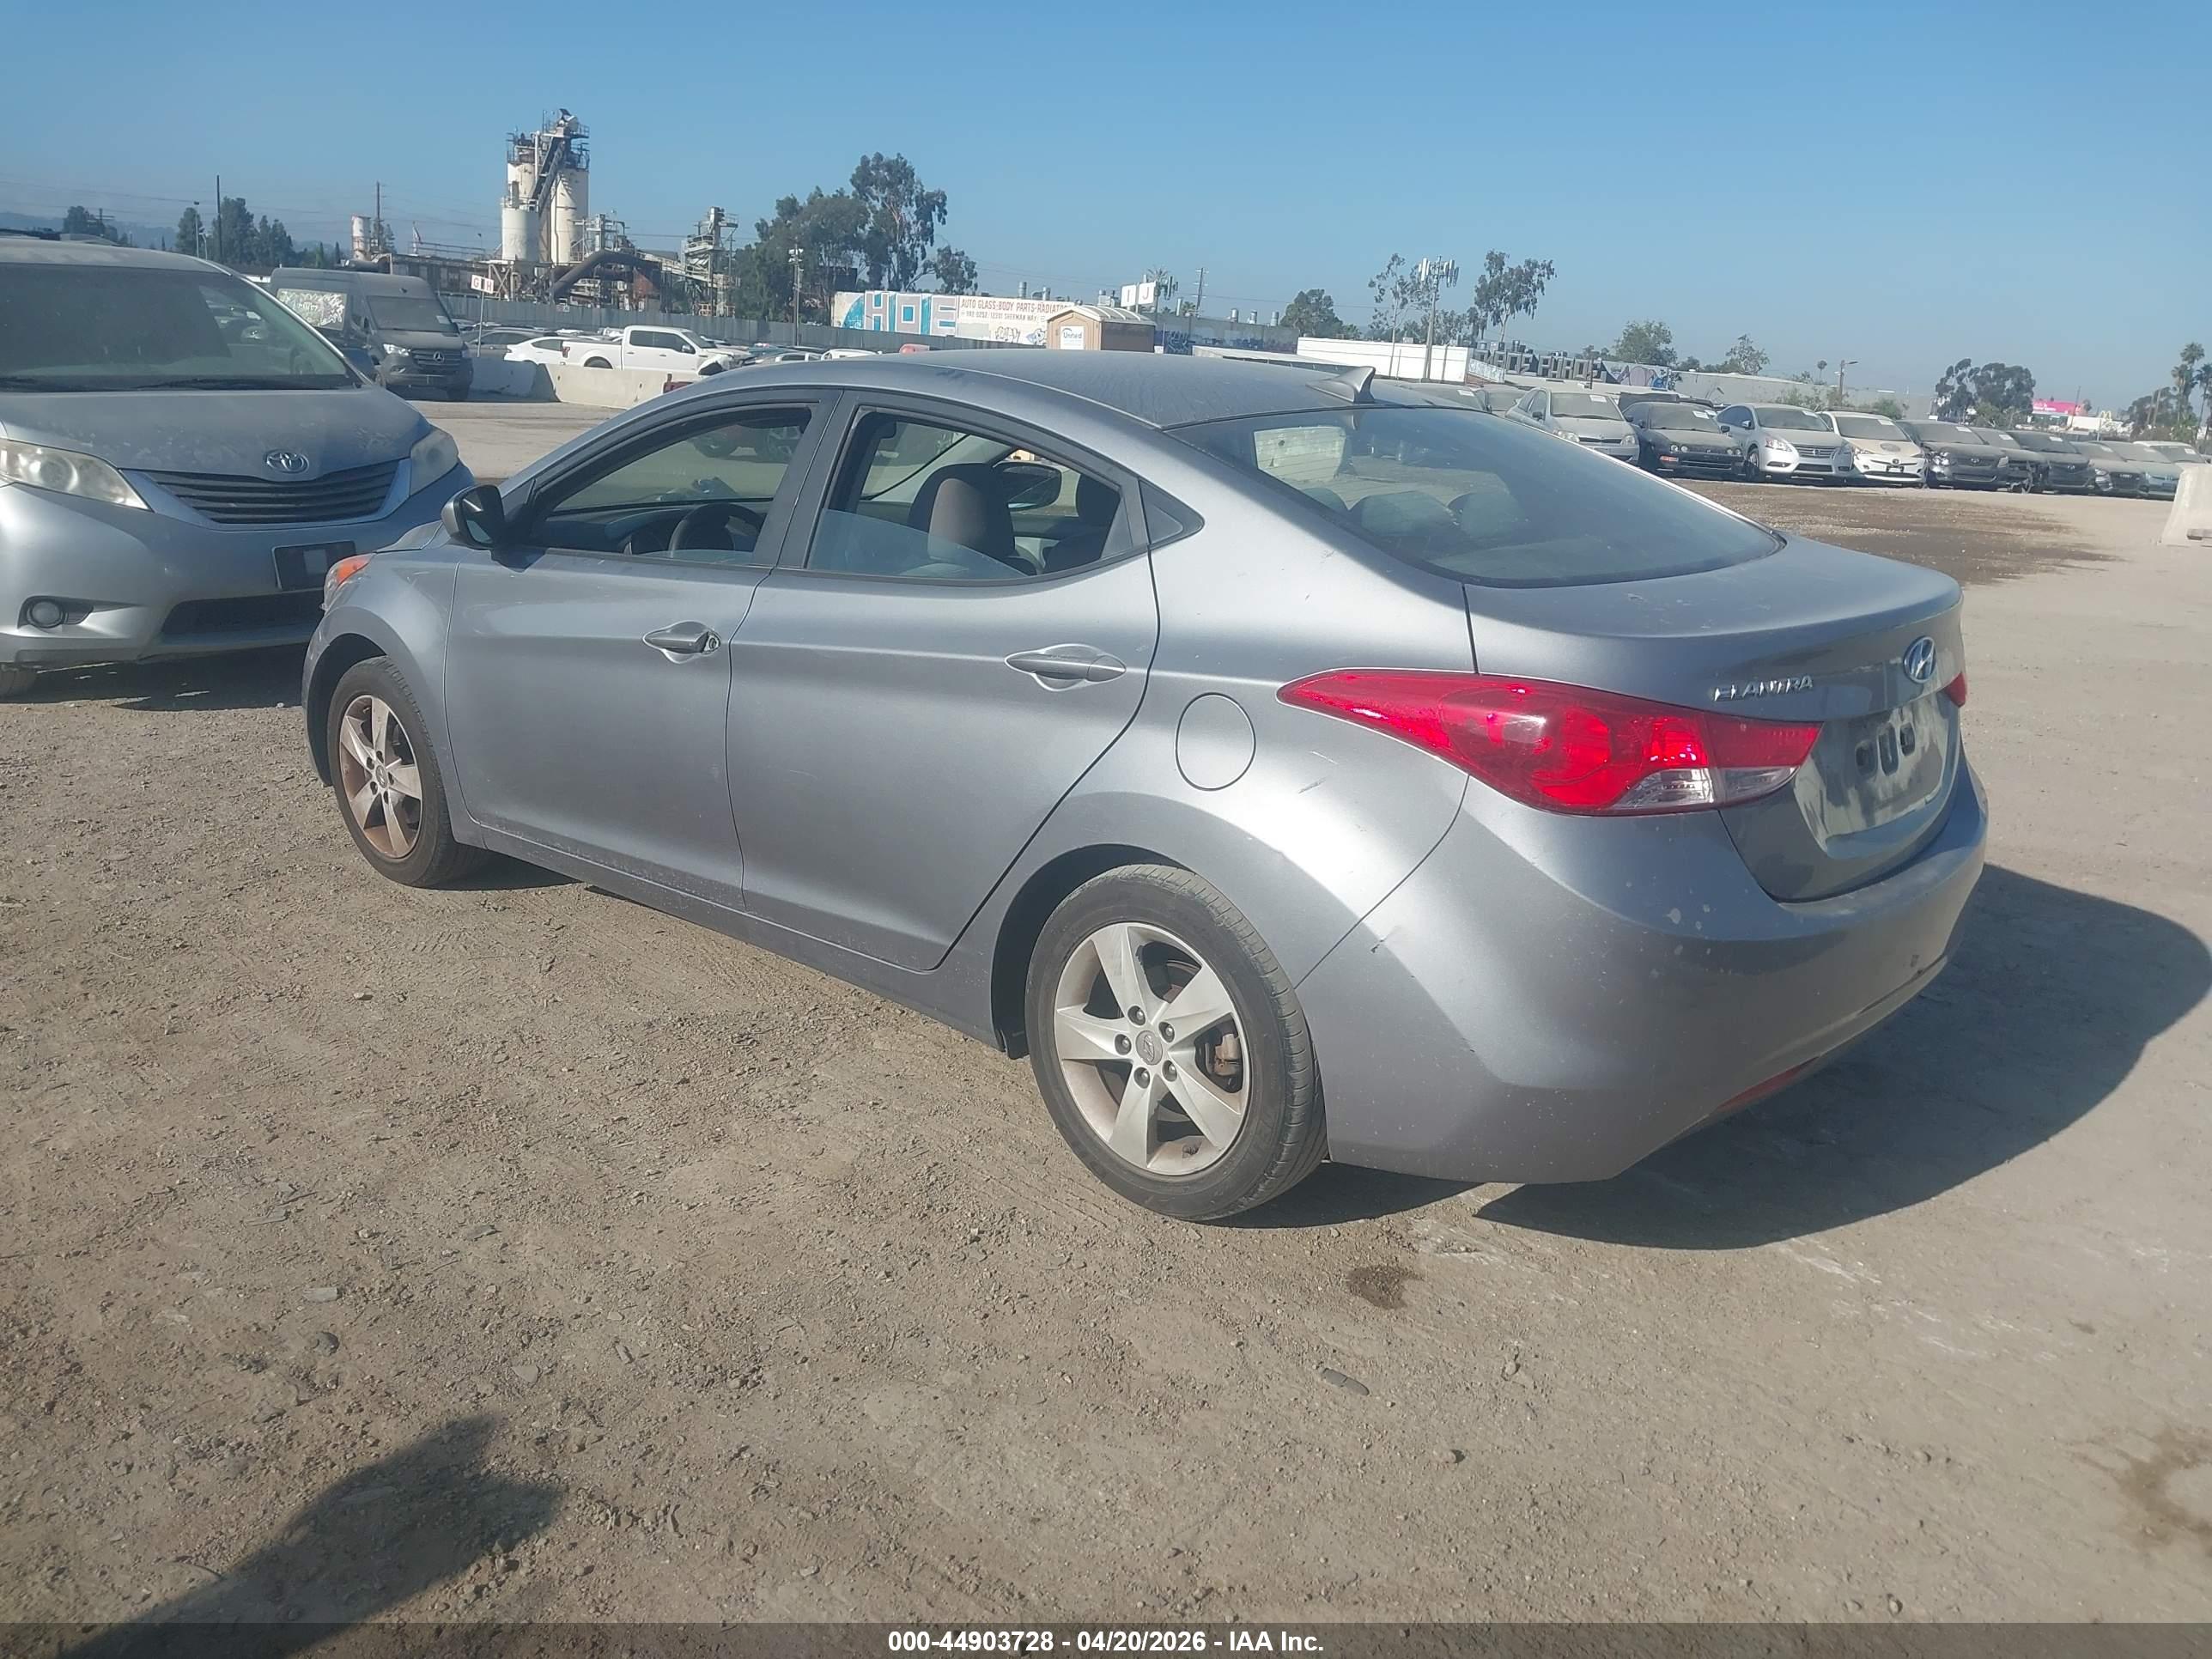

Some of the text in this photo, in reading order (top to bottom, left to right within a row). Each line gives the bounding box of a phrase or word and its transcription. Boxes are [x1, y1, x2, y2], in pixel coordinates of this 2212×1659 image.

[473, 277, 492, 292] G H
[1142, 287, 1150, 300] J
[961, 299, 976, 309] AUTO
[1714, 675, 1814, 702] ELANTRA
